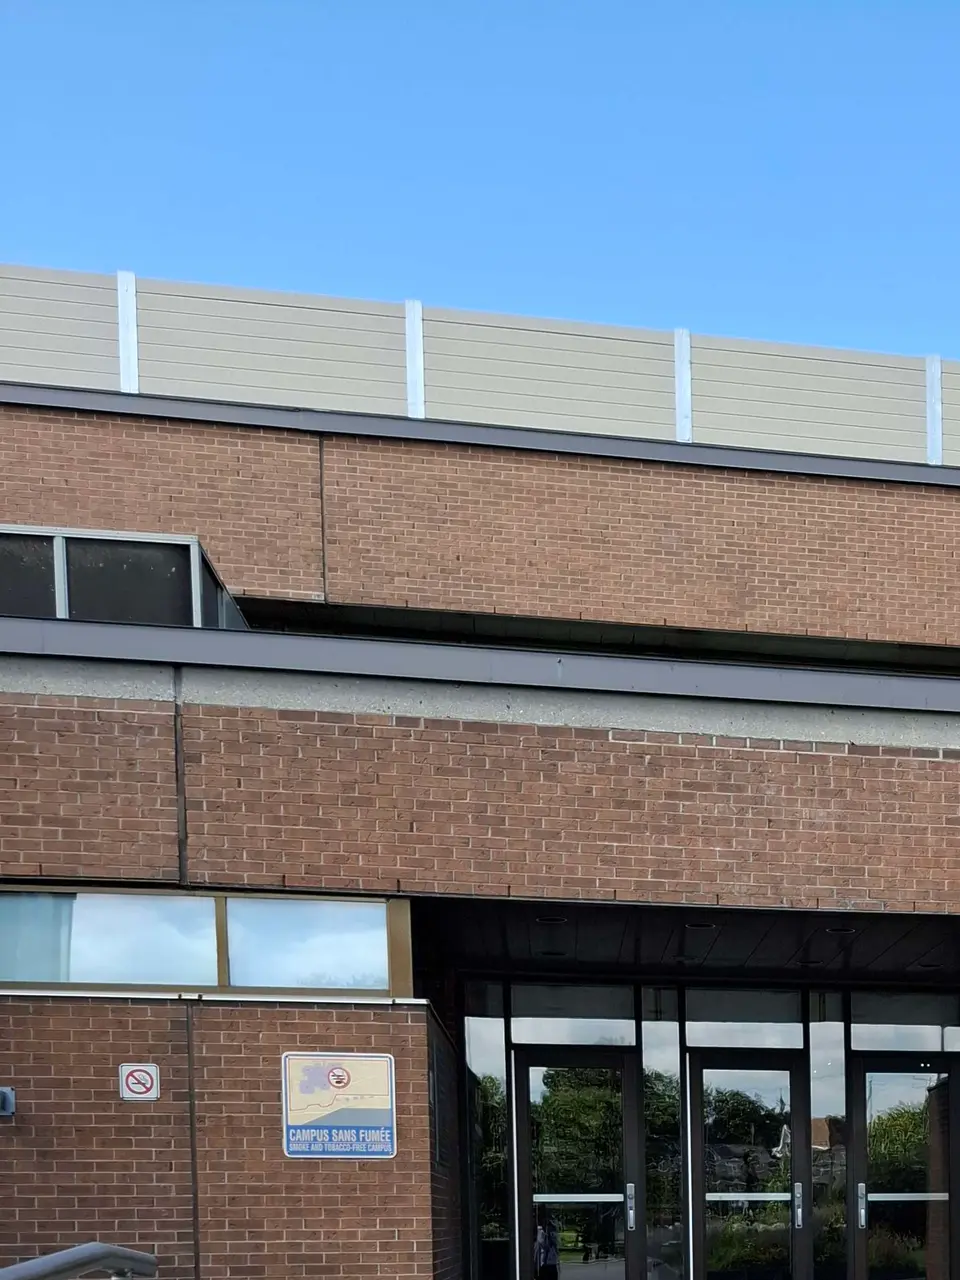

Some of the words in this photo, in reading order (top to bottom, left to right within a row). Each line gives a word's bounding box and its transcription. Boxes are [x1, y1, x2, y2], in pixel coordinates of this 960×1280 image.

[289, 1129, 329, 1141] CAMPUS
[332, 1129, 357, 1141] SANS
[359, 1127, 391, 1141] FUMÉE
[289, 1143, 310, 1151] SMOKE
[310, 1143, 323, 1151] AND
[367, 1144, 392, 1152] CAMPUS
